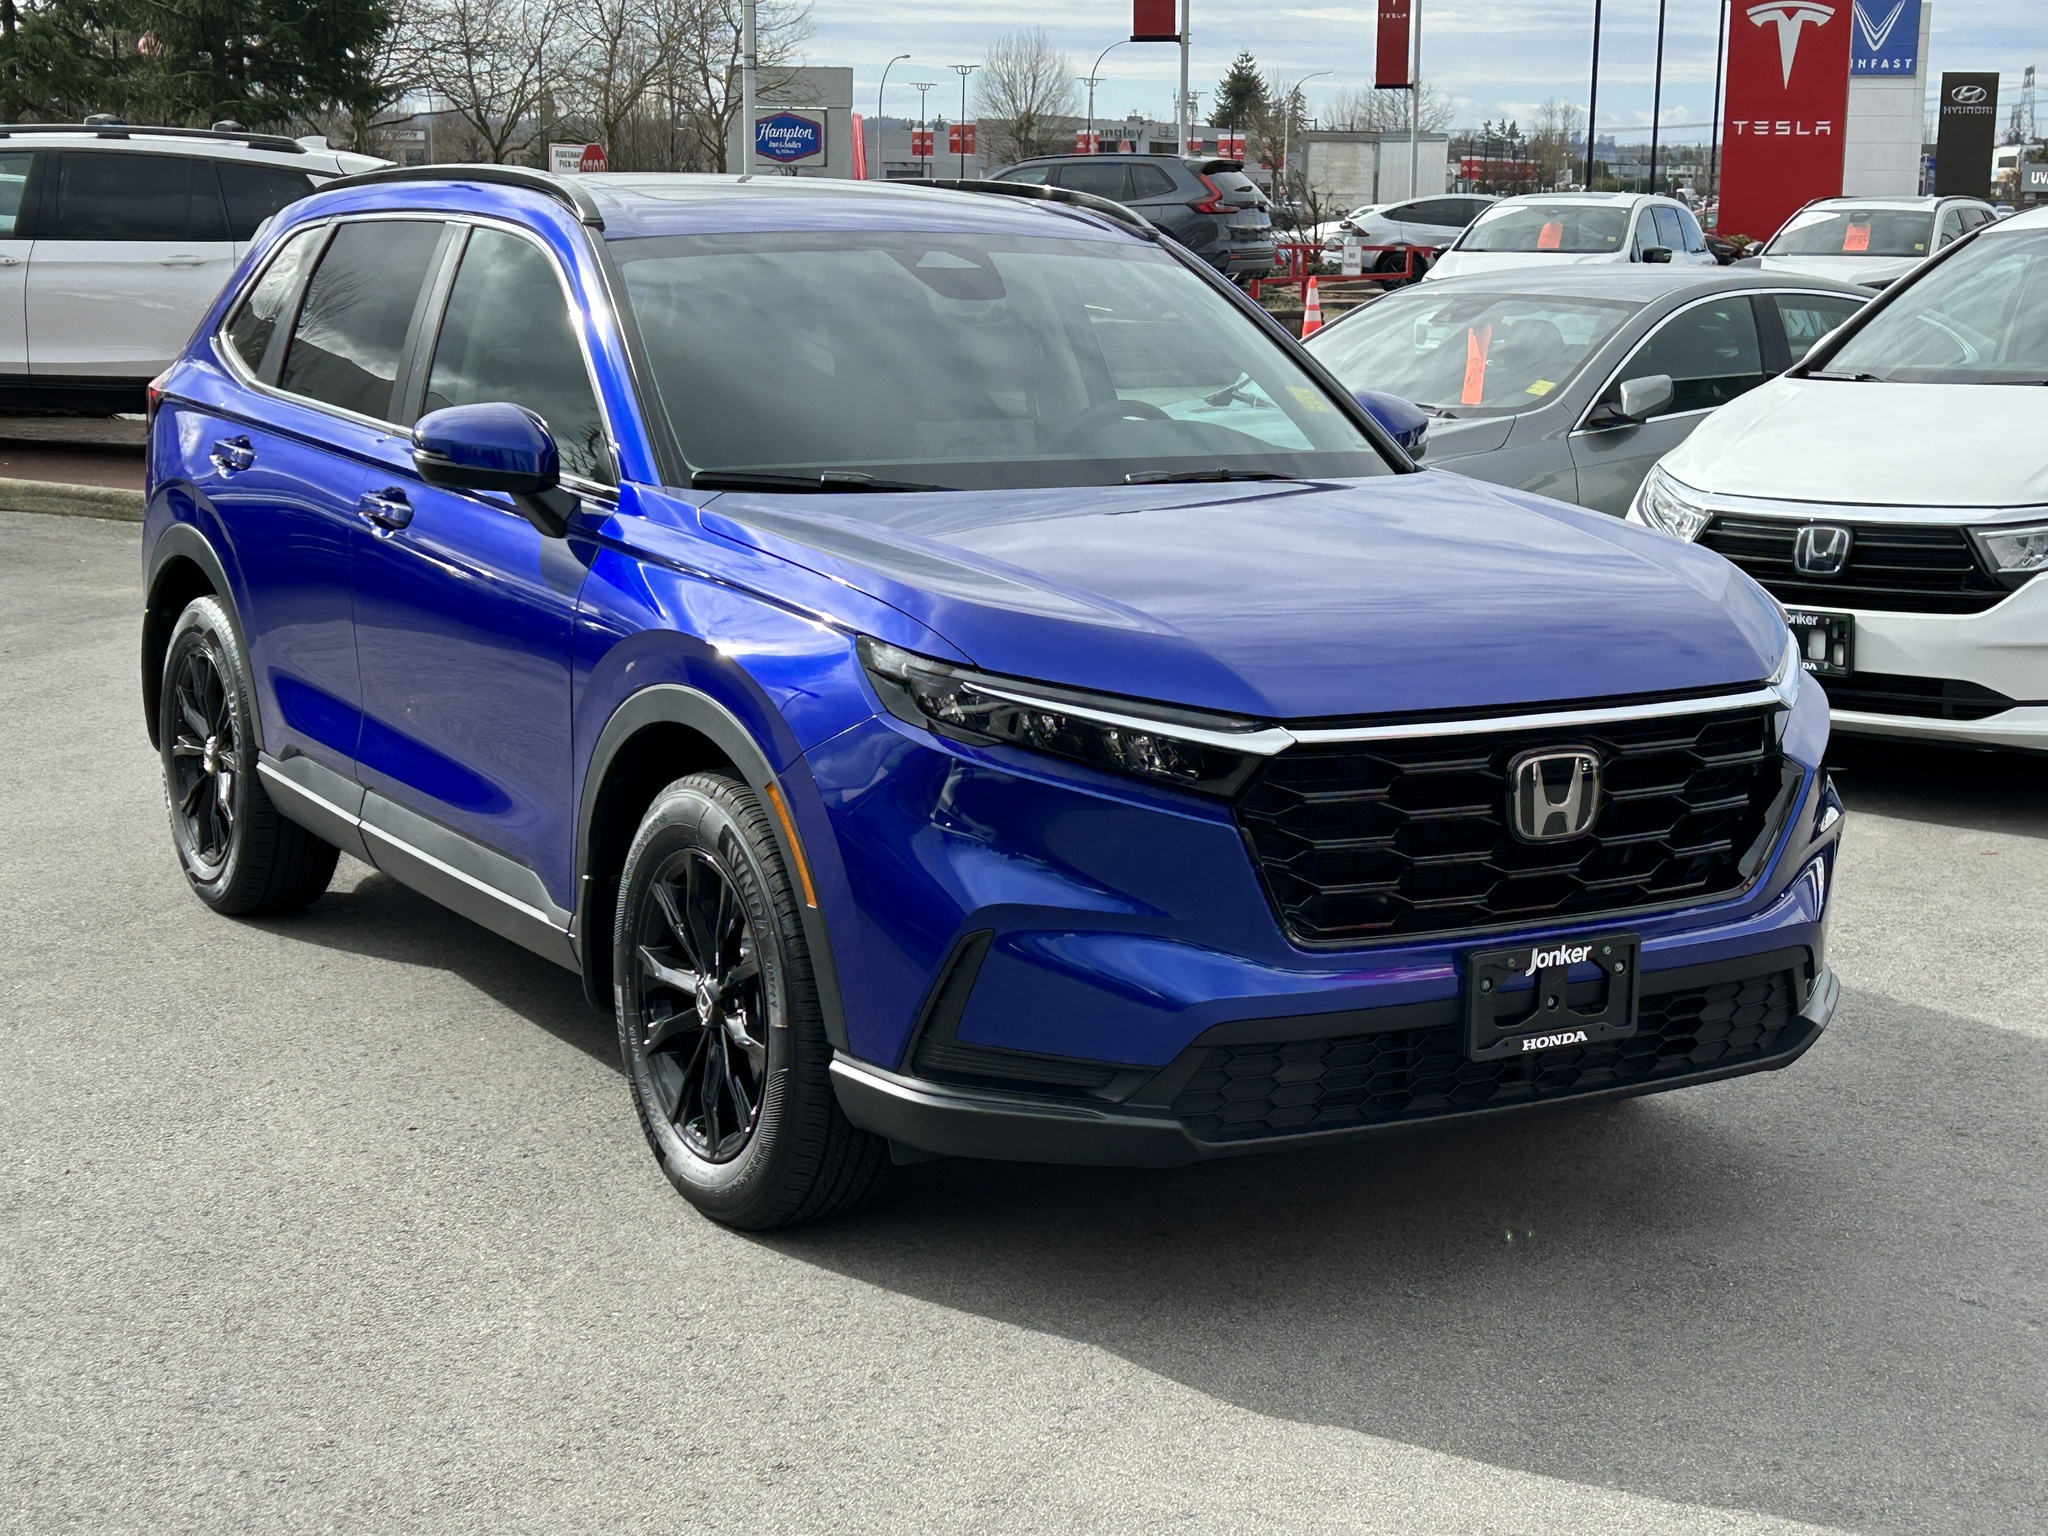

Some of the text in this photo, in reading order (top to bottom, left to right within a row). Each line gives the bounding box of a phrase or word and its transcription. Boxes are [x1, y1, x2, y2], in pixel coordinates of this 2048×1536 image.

[1850, 58, 1913, 69] INFAST
[1943, 106, 1993, 115] HYUNDAI
[757, 122, 815, 144] Hampton
[1098, 126, 1143, 140] angley
[1732, 120, 1831, 136] TESLA
[559, 160, 580, 169] PICK-U
[2031, 171, 2048, 185] UV
[1787, 612, 1818, 626] onker
[1525, 944, 1593, 977] Jonker
[1521, 1030, 1588, 1051] HONDA
